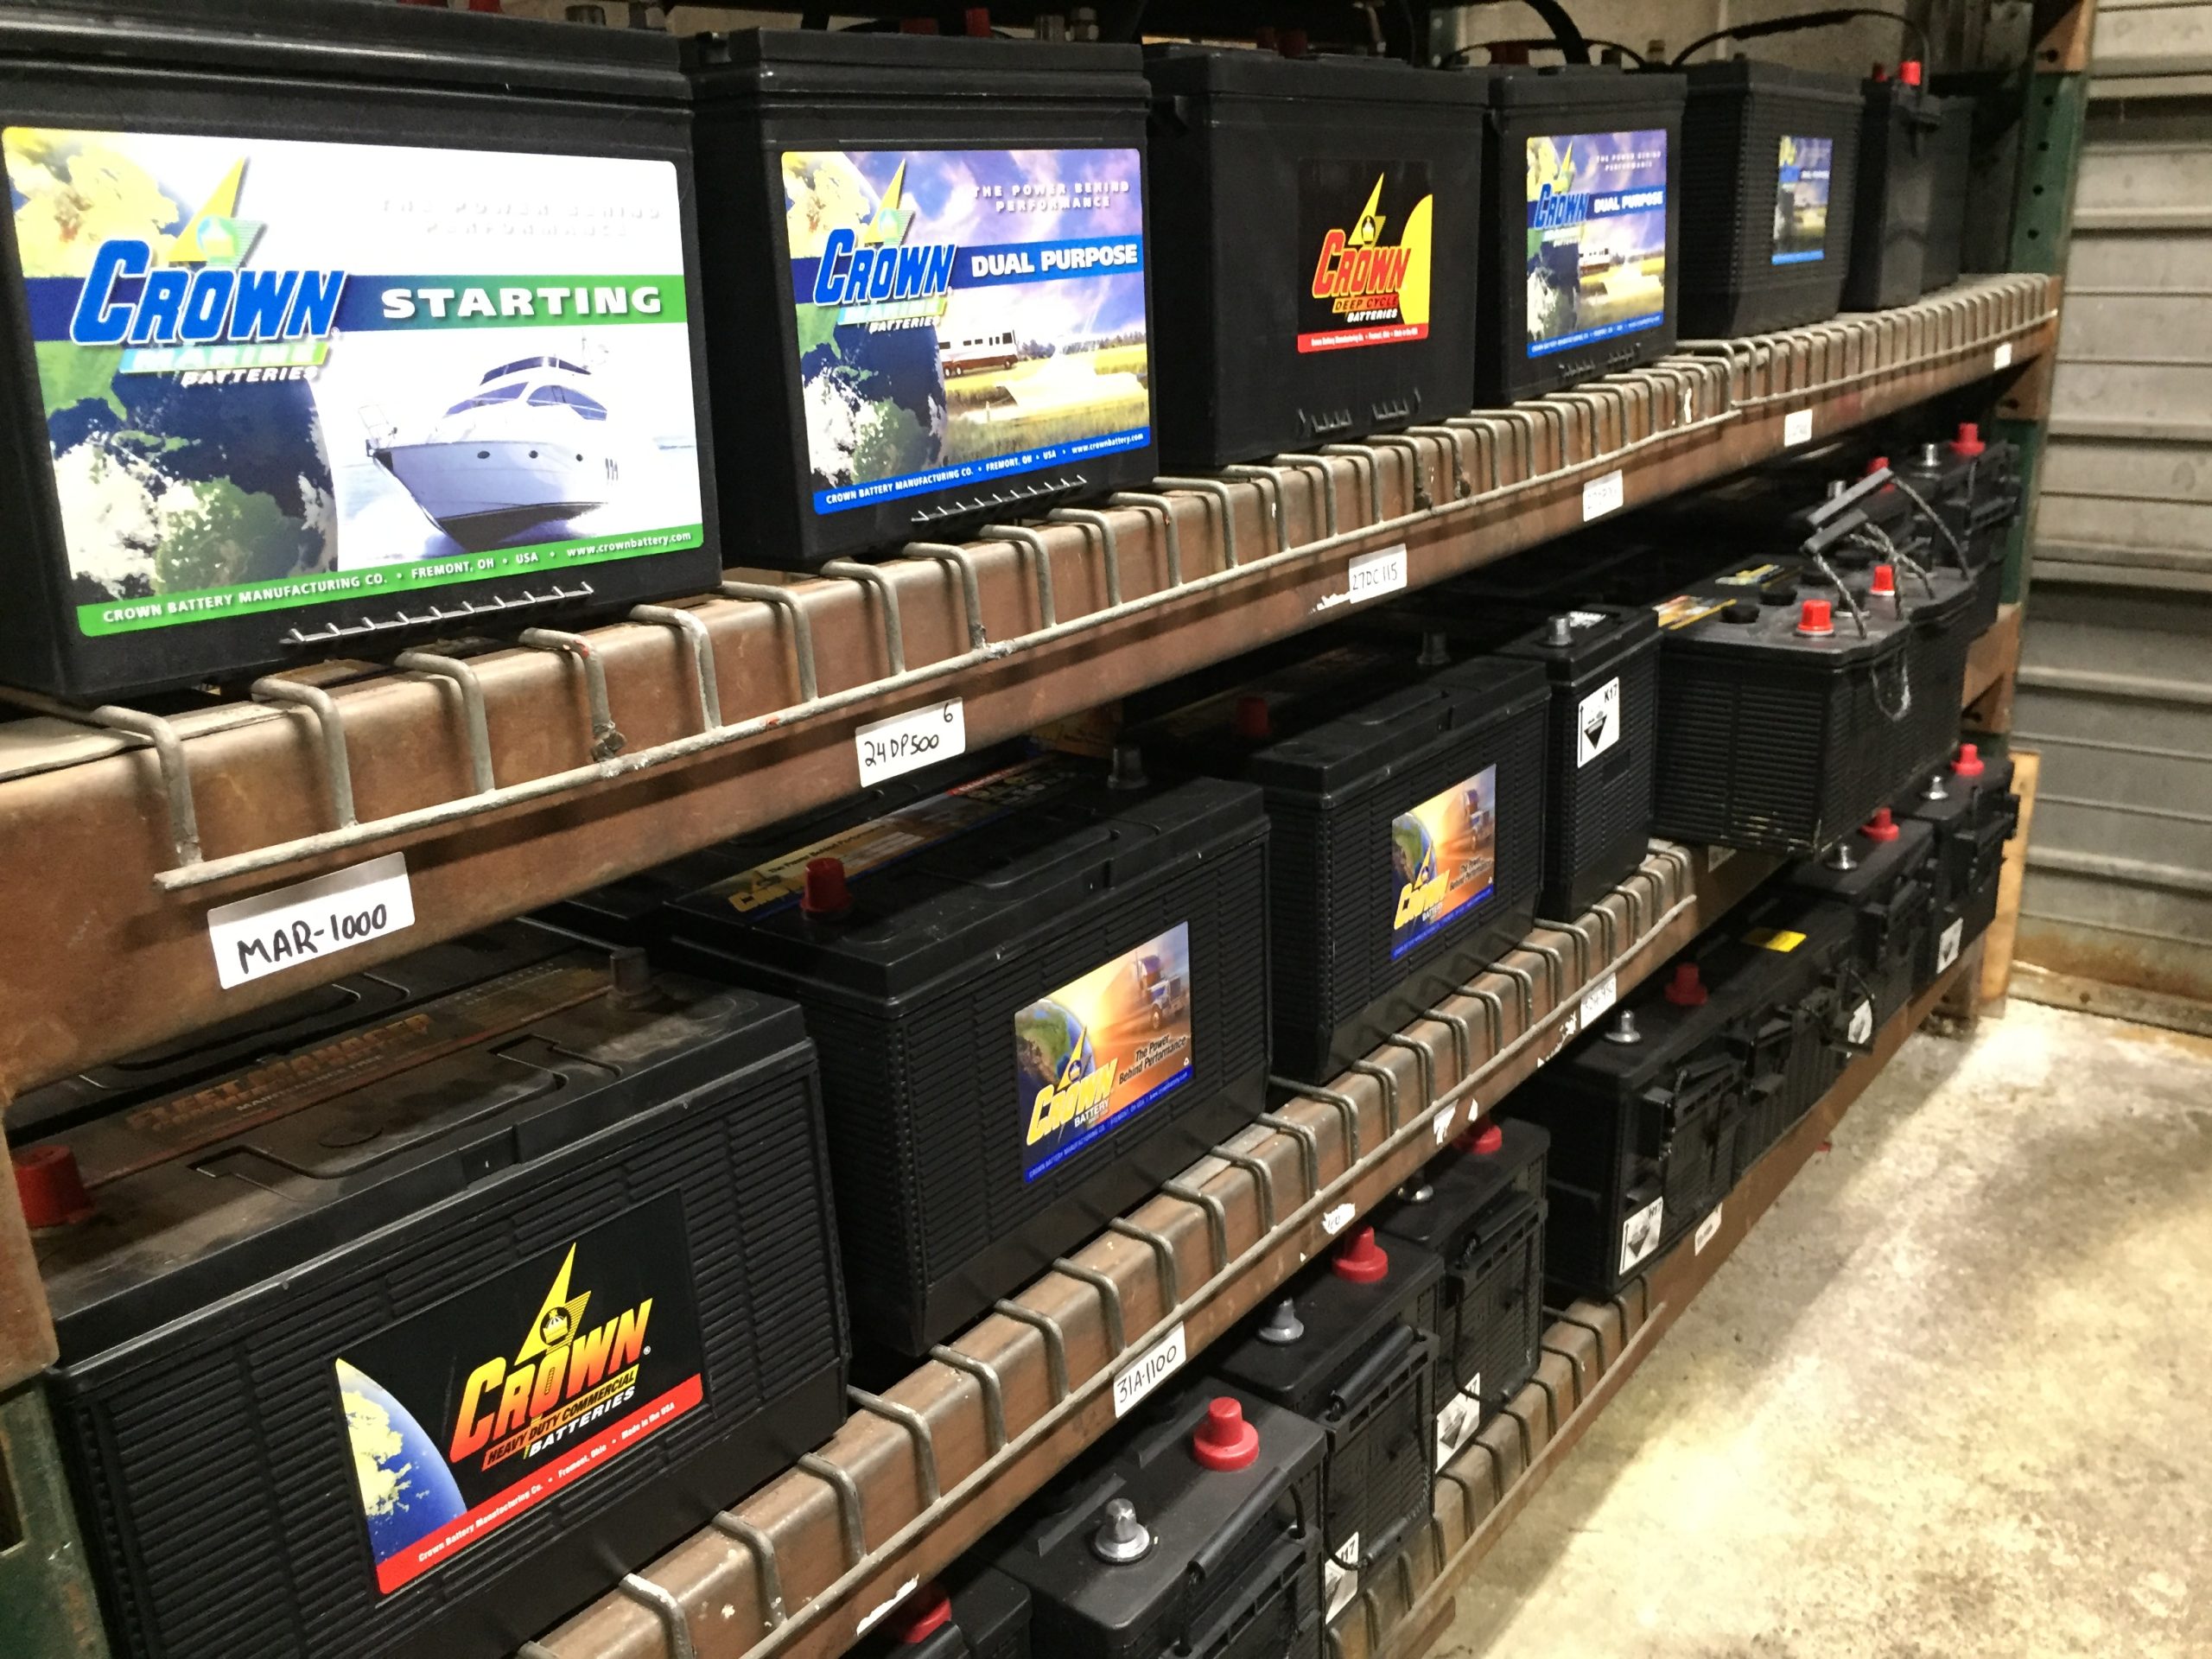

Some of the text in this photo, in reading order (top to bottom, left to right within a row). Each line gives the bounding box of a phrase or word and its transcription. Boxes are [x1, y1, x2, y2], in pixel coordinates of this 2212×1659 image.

[995, 196, 1111, 213] PERFORMANCE
[1012, 182, 1066, 196] POWER
[1074, 181, 1129, 194] BEHIND
[1534, 182, 1590, 230] CROWN
[1593, 190, 1663, 213] DUAL PURPOSE
[812, 227, 958, 307] CROWN
[971, 244, 1138, 278] DUAL PURPOSE
[1312, 228, 1412, 299] CROWN
[69, 238, 346, 346] CROWN
[381, 286, 662, 320] STARTING
[1335, 295, 1398, 312] DEEP CYCLE
[1346, 308, 1398, 323] BATTERIES
[180, 365, 320, 388] BATTERIES
[825, 433, 1144, 505] CROWN BATTERY MANUFACTURING CO. FREMONT, OH USA www.crownbattery.com
[103, 531, 692, 624] CROWN BATTERY MANUFACTURING CO. FREMONT, OH USA www.crownbattery.com
[943, 702, 954, 723] 6
[237, 903, 388, 975] MAR-1000
[1119, 1036, 1186, 1085] Behind Performance
[1135, 1034, 1170, 1062] The Power
[1026, 1058, 1119, 1146] CROWN
[1074, 1097, 1109, 1128] BATTERY
[448, 1298, 653, 1464] CROWN
[487, 1370, 636, 1465] HEAVY DUTY COMMERCIAL
[528, 1385, 636, 1458] BATTERIES
[418, 1402, 676, 1563] Crown Battery Manufacturing Co. Fremont, Ohio Made in the USA
